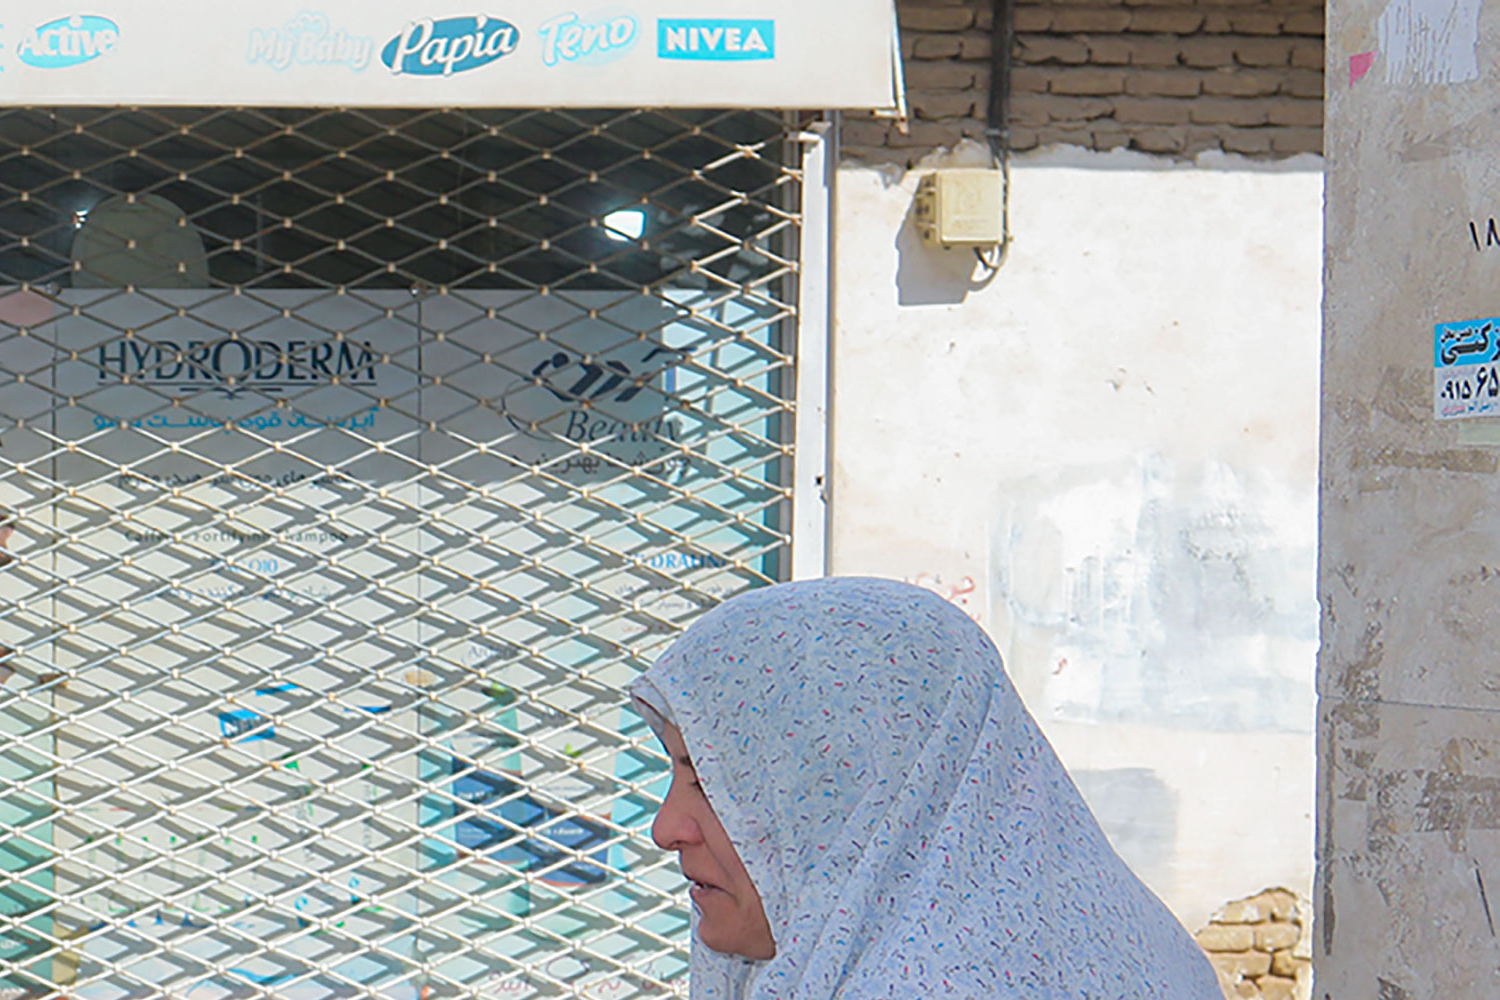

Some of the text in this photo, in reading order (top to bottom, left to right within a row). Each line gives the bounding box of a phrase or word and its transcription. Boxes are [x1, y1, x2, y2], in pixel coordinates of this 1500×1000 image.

[19, 14, 119, 57] Active
[246, 27, 374, 73] My Baby
[389, 15, 519, 76] Papia
[540, 13, 636, 66] Teno
[665, 26, 769, 53] NIVEA
[100, 338, 376, 382] HYDRODERM
